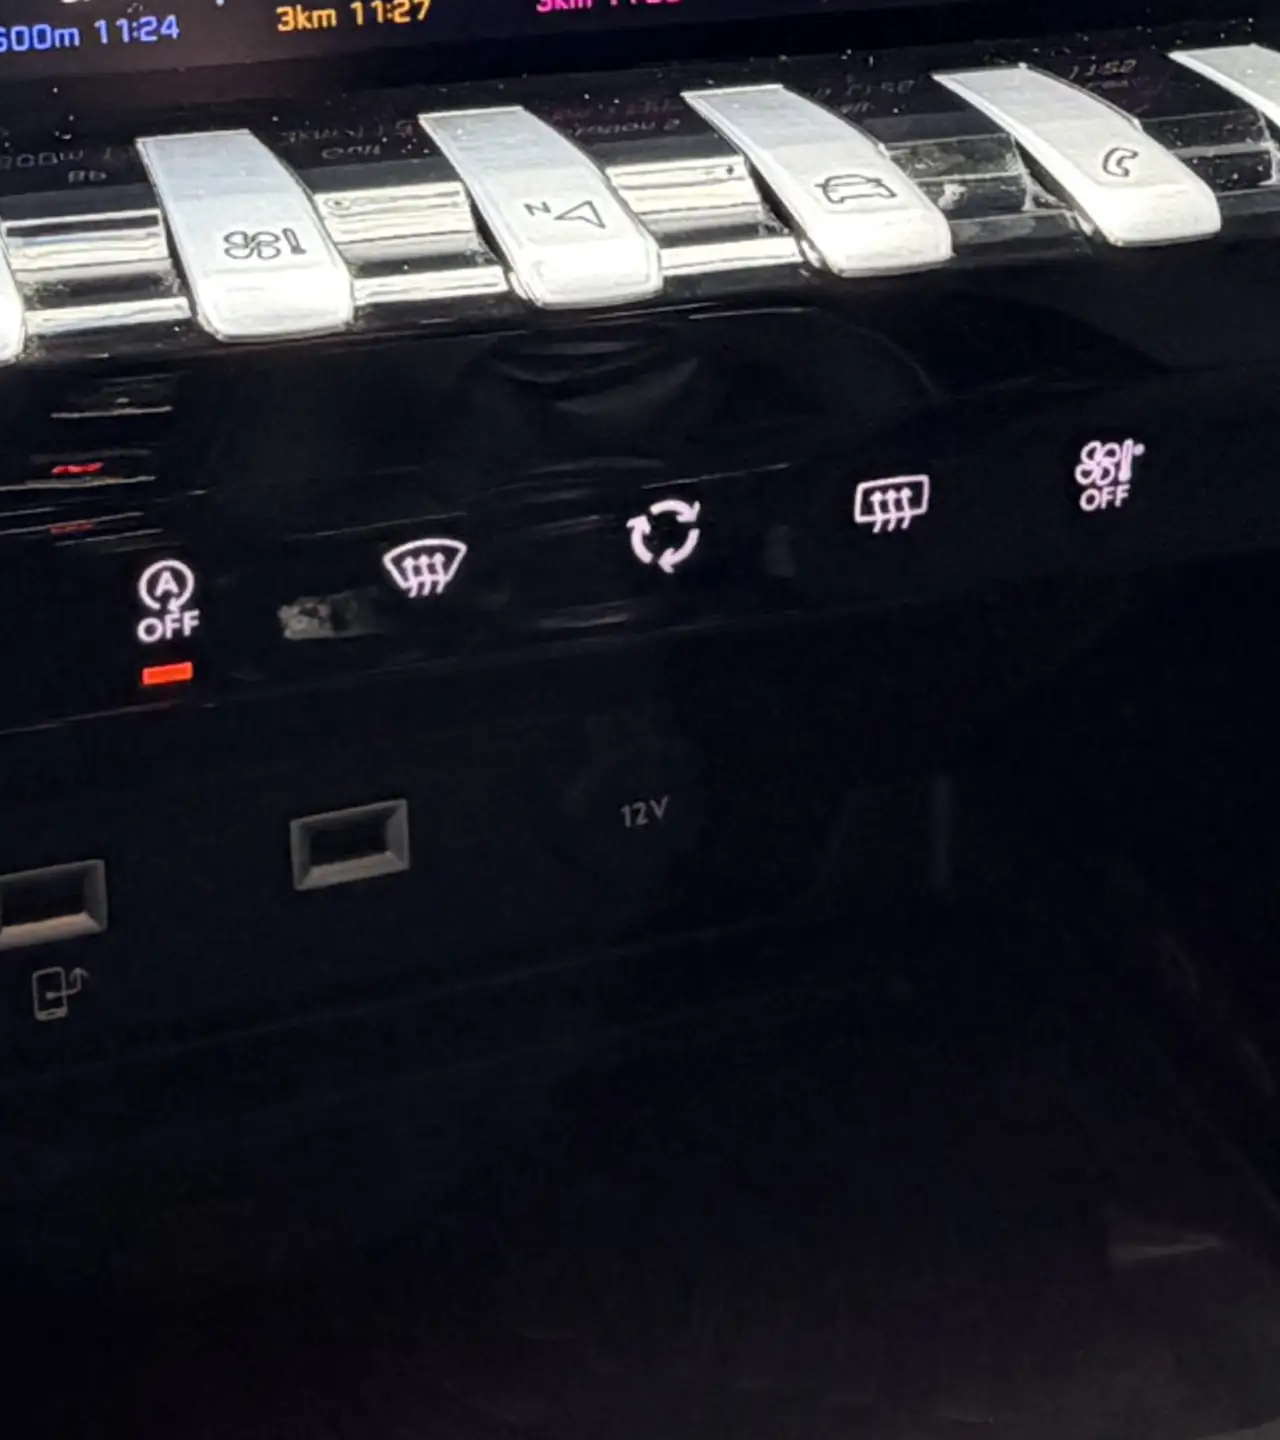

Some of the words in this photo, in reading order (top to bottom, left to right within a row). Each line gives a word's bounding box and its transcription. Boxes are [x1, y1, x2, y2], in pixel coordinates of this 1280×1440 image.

[93, 13, 181, 45] 11:24
[276, 3, 338, 32] 3km
[1080, 484, 1132, 512] OFF
[154, 569, 180, 598] A
[136, 608, 201, 643] OFF
[620, 795, 670, 828] 12V
